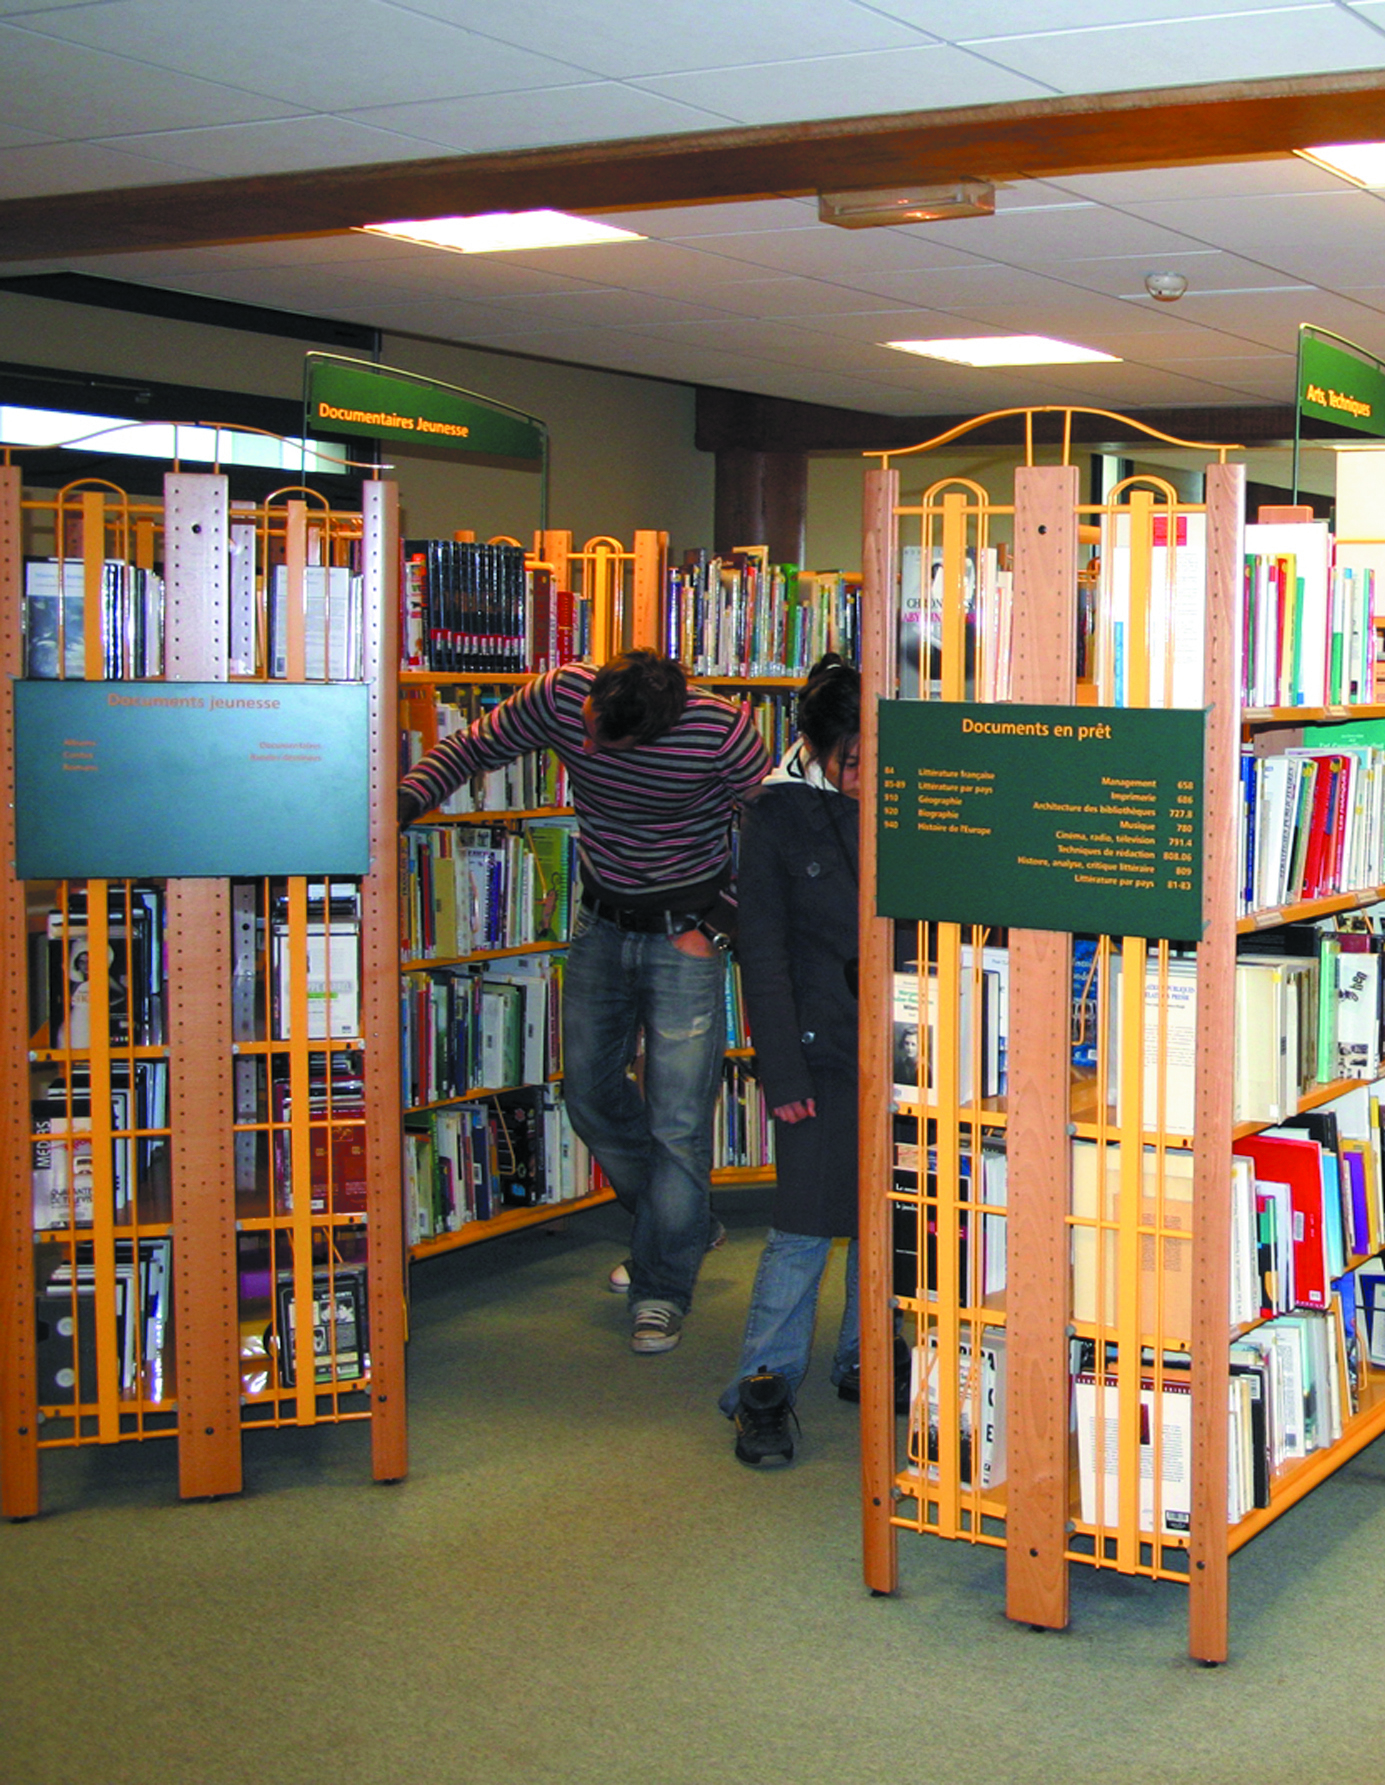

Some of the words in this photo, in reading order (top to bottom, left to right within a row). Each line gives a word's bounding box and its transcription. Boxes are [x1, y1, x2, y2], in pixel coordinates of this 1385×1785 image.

[1306, 384, 1327, 407] Arts,
[1328, 389, 1372, 418] Techniques
[318, 403, 414, 430] Documentaires
[416, 417, 470, 438] Jeunesse
[107, 692, 205, 709] Documents
[208, 694, 281, 712] jeunesse
[962, 718, 1050, 737] Documents
[1054, 724, 1073, 738] en
[1078, 723, 1112, 741] prêt
[918, 768, 958, 777] Littérature
[960, 770, 995, 781] française
[918, 782, 958, 791] Littérature
[960, 785, 973, 793] par
[975, 786, 993, 795] pays
[1101, 777, 1157, 788] Management
[918, 795, 963, 806] Géographie
[1111, 792, 1157, 802] Imprimerie
[918, 809, 959, 819] Biographie
[1033, 801, 1082, 812] Architecture
[1084, 805, 1098, 813] des
[1100, 805, 1156, 817] bibliothèques
[1169, 809, 1193, 819] 727.8
[918, 822, 947, 832] Histoire
[1119, 820, 1156, 831] Musique
[1055, 831, 1088, 841] Cinéma,
[1090, 833, 1114, 842] radio,
[1116, 835, 1155, 845] télévision
[1168, 838, 1193, 847] 791.4
[1057, 845, 1102, 856] Techniques
[1116, 849, 1155, 859] rédaction
[1163, 852, 1193, 861] 808.06
[1017, 856, 1050, 866] Histoire,
[1052, 860, 1084, 869] analyse,
[1086, 861, 1118, 872] critique
[1119, 863, 1155, 873] littéraire
[1074, 874, 1118, 885] Littérature
[1119, 879, 1133, 887] par
[1135, 880, 1155, 889] pays
